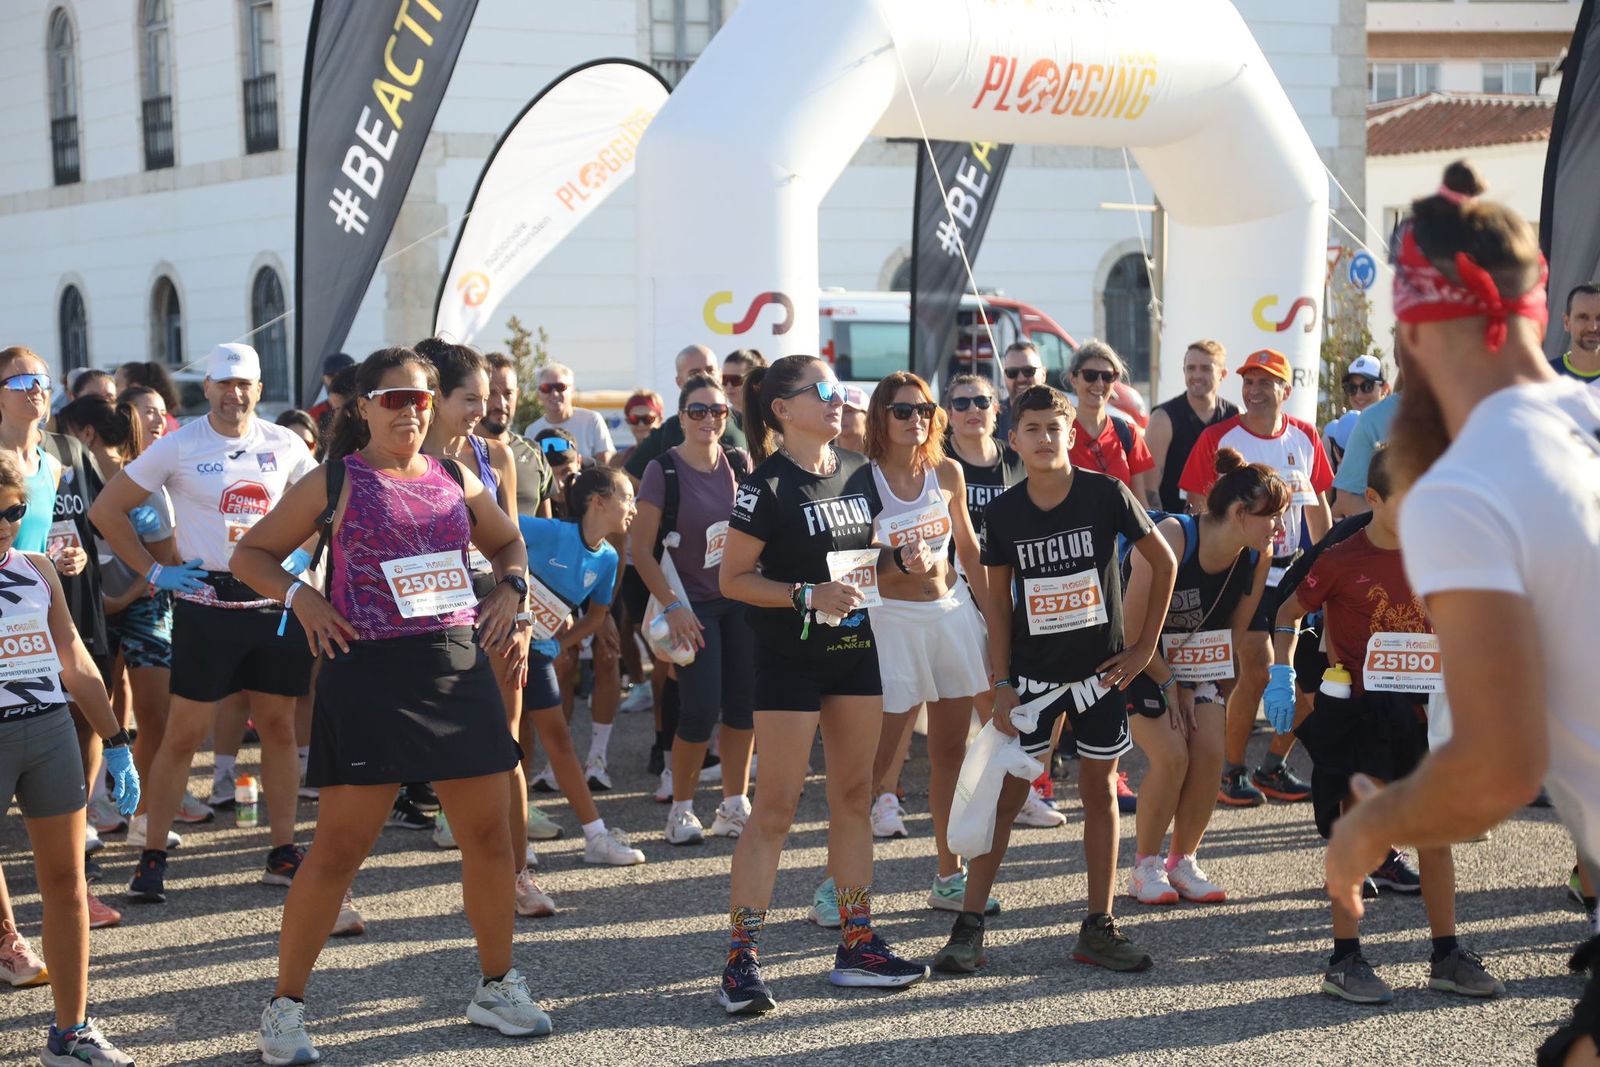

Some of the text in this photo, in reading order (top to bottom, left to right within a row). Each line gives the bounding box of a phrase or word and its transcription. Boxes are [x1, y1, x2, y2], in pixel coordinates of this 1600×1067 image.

[971, 55, 1157, 120] PLOGGING
[229, 492, 267, 509] PONLE
[803, 497, 872, 537] FITCLUB
[896, 521, 945, 547] 25188
[1016, 530, 1095, 570] FITCLUB
[398, 570, 462, 595] 25069
[1033, 590, 1095, 613] 25780
[1172, 646, 1226, 663] 25756
[1373, 653, 1436, 670] 25190
